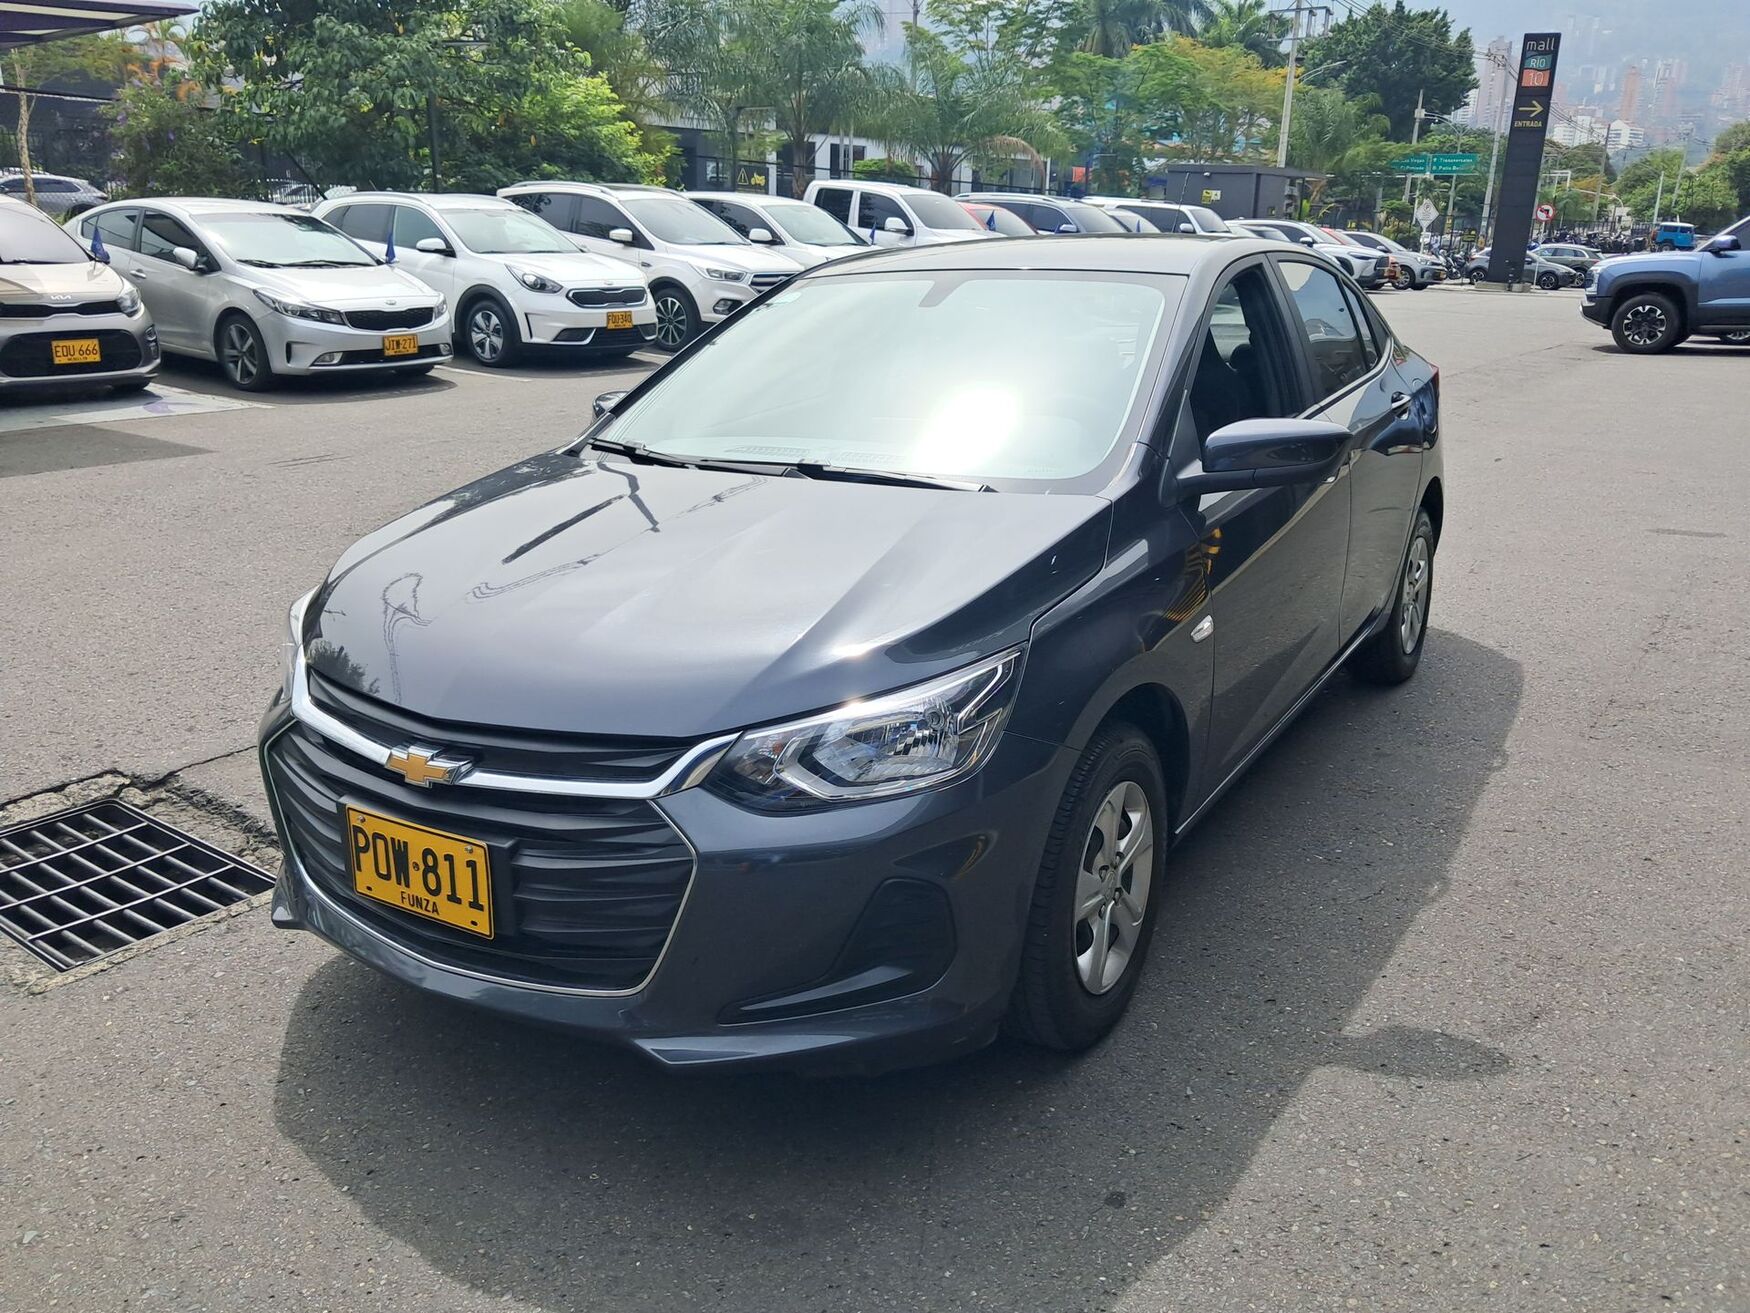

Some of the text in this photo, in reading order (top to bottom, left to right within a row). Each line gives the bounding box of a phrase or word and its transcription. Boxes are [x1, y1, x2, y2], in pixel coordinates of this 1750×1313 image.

[1526, 37, 1555, 51] mall
[1529, 71, 1544, 86] 10
[1514, 120, 1543, 128] ENTRADA
[78, 344, 98, 356] 666
[352, 824, 485, 912] POW 811
[400, 891, 440, 916] FUNZA
